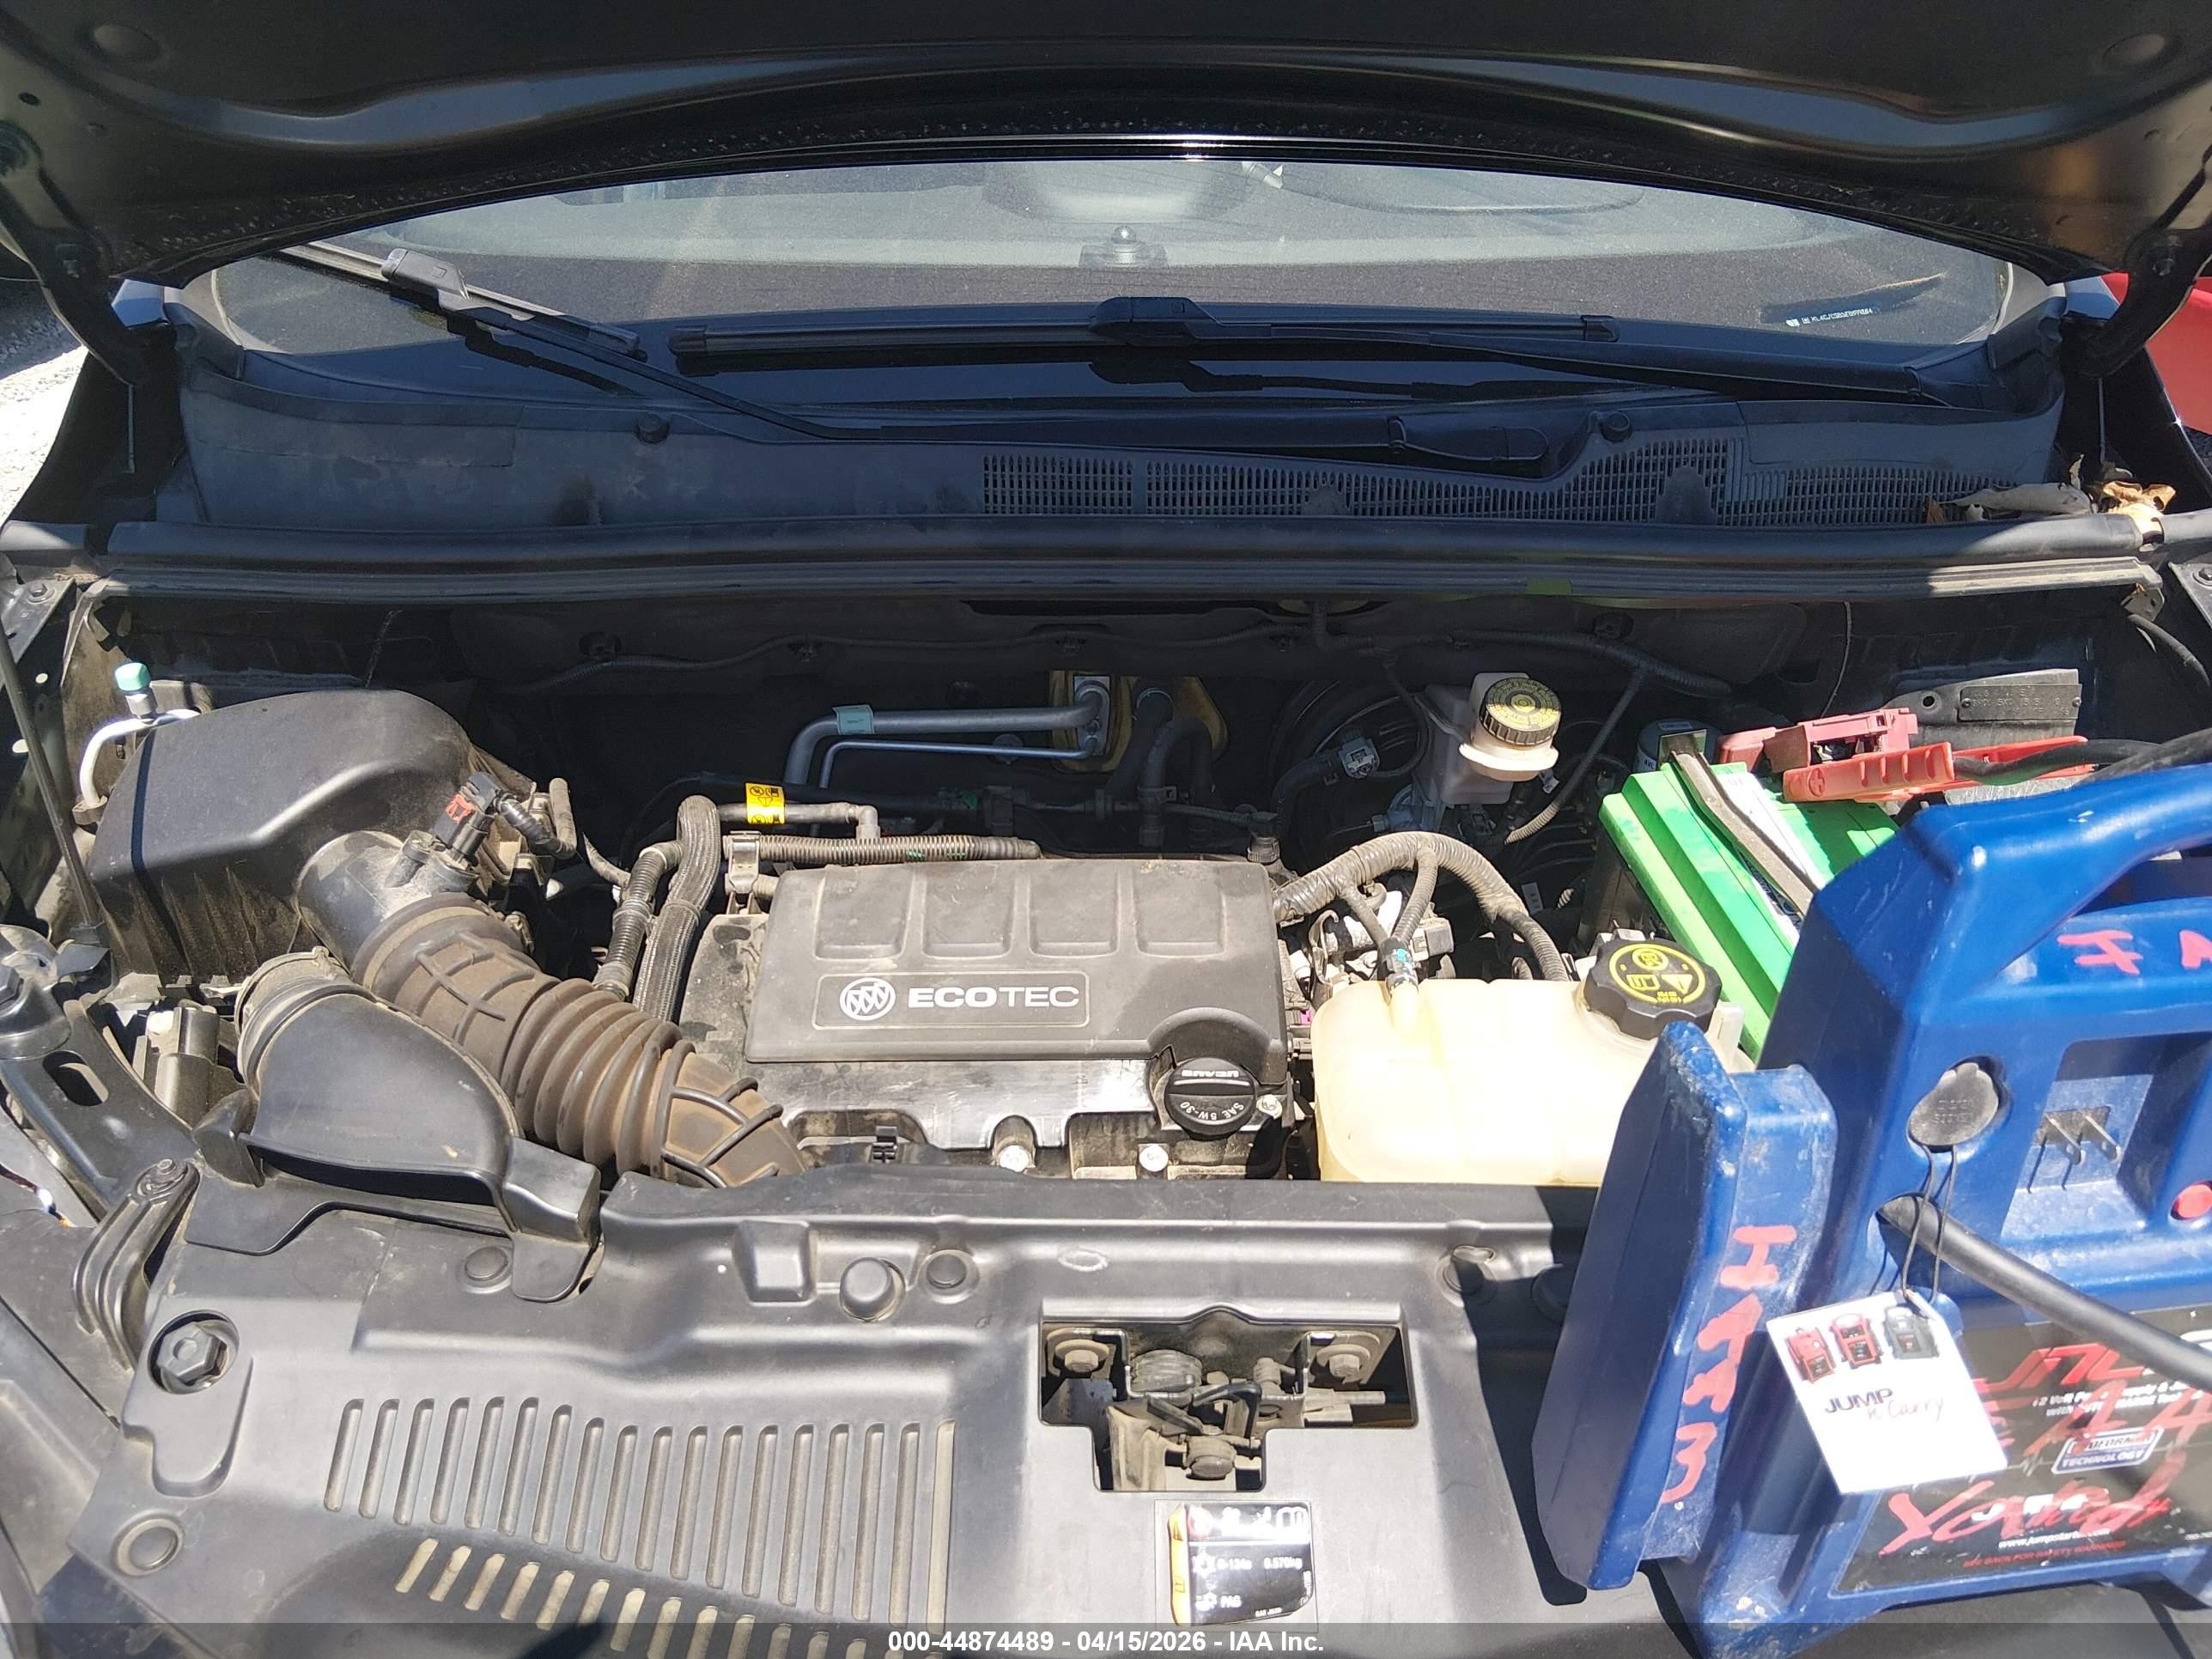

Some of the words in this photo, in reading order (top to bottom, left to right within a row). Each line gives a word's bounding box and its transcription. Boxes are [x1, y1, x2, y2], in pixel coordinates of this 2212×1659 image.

[908, 985, 1080, 1009] ECOTEC
[1180, 1101, 1218, 1121] 5W-30
[1221, 1102, 1244, 1118] SAE
[1824, 1388, 1893, 1413] JUMP
[2062, 1450, 2144, 1468] TECHNOLOGY
